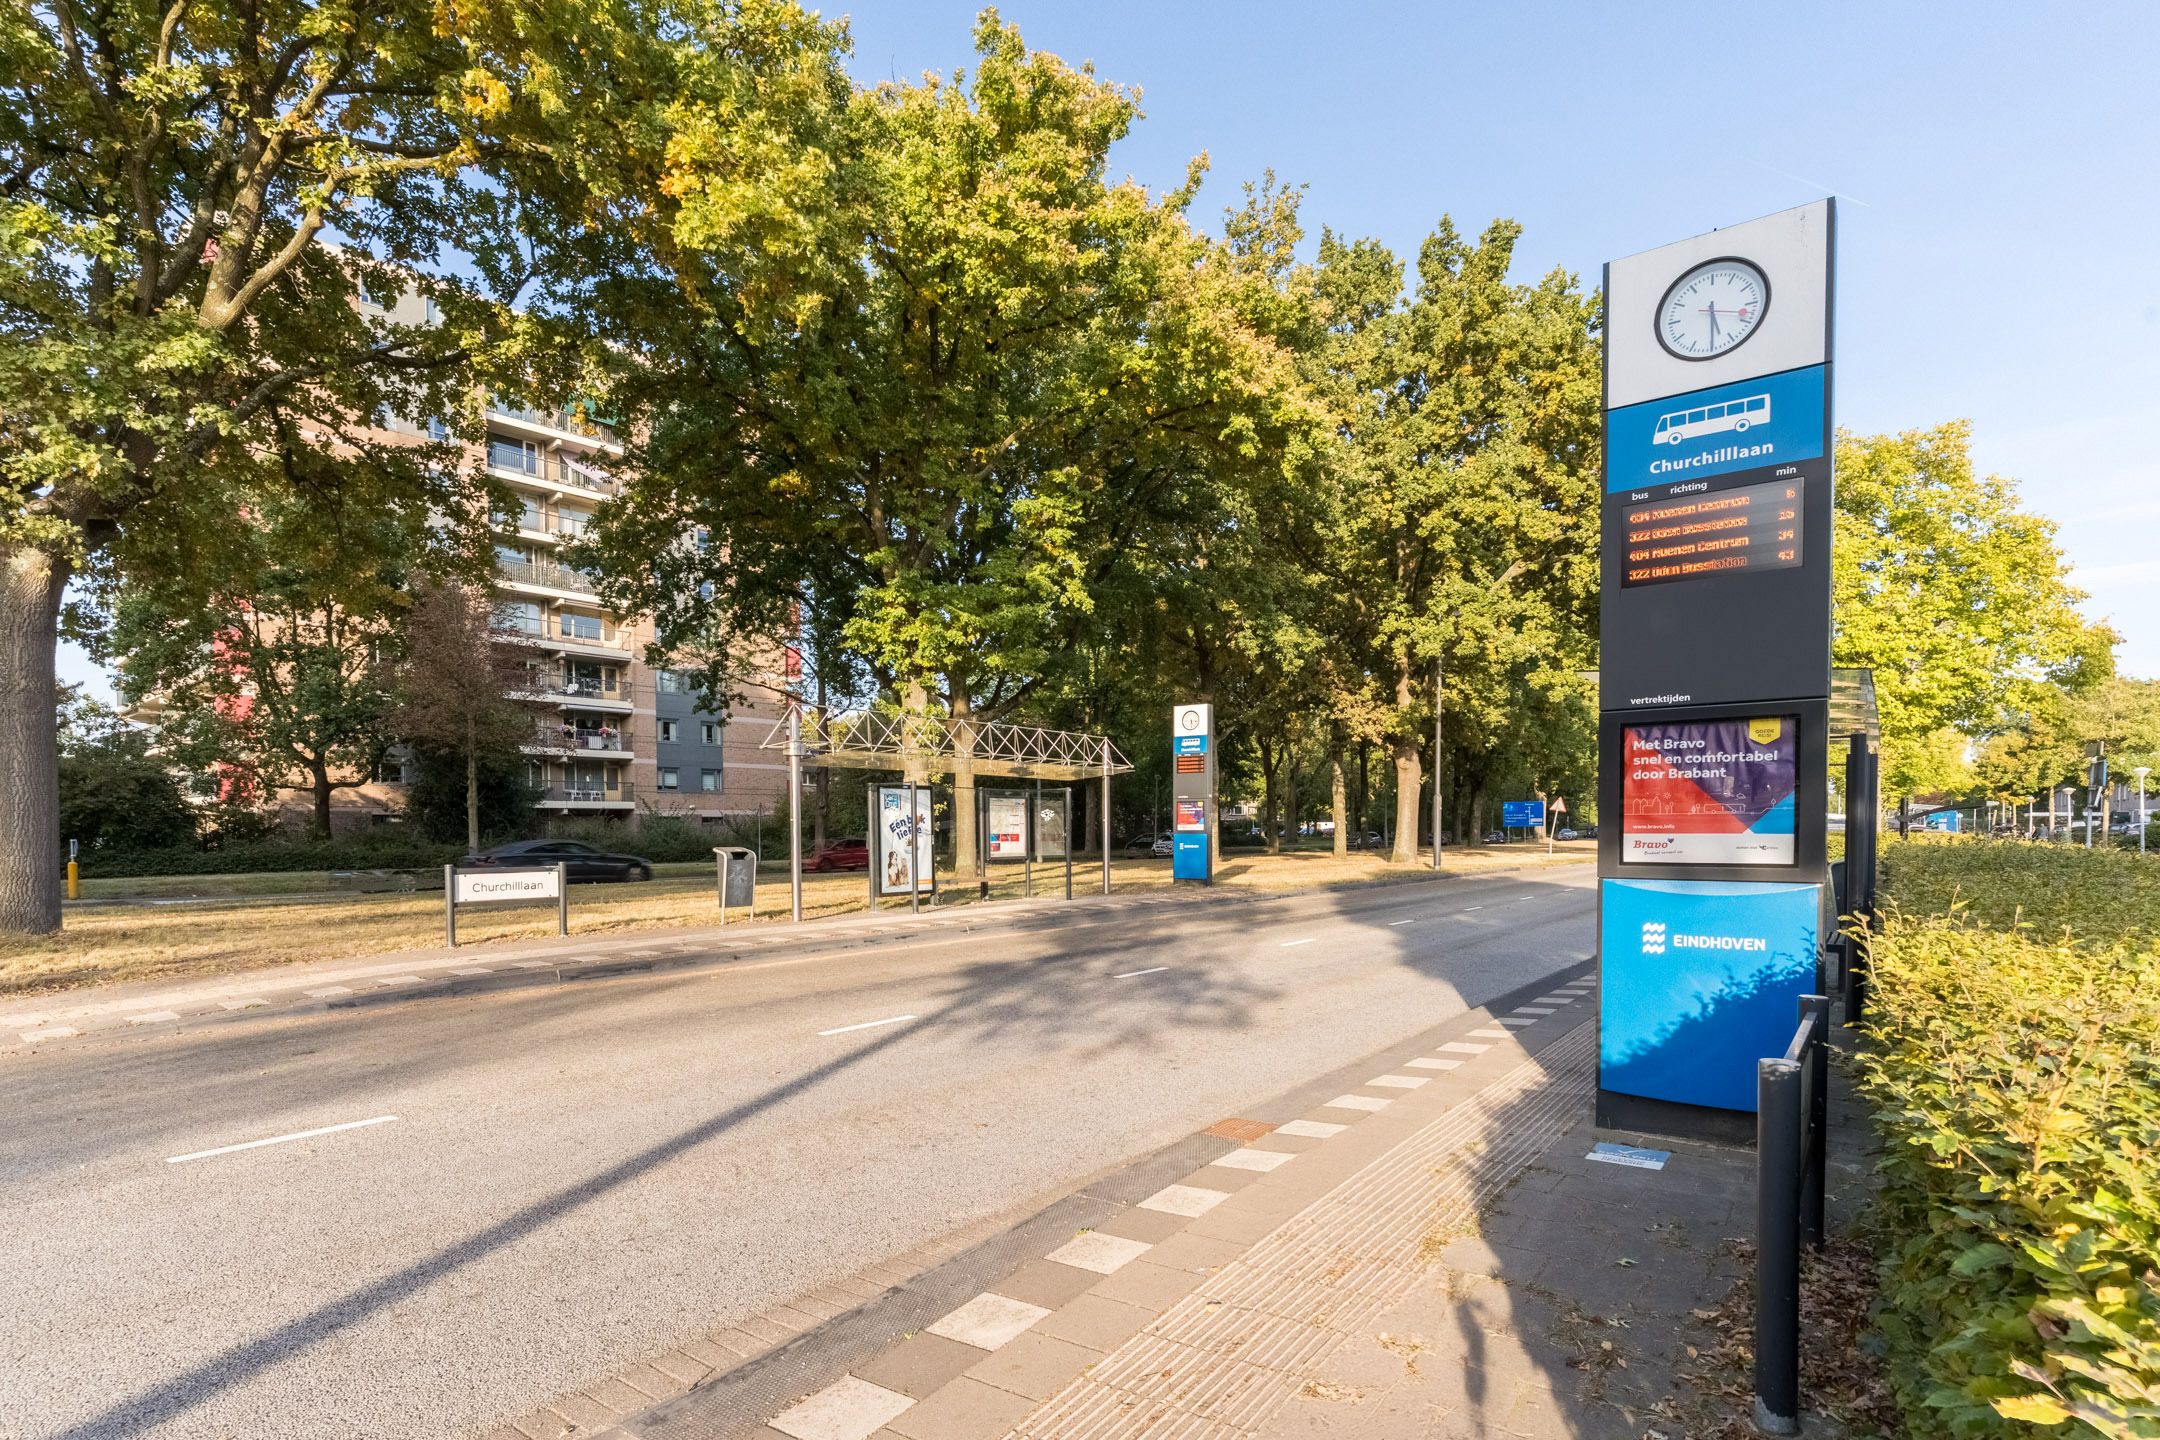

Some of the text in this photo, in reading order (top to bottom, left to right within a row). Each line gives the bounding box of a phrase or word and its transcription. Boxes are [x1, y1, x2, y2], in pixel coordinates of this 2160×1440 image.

[1650, 443, 1774, 474] Churchilllaan
[1632, 465, 1797, 501] bus richting min
[1652, 544, 1696, 558] Nuenen
[1698, 537, 1749, 552] Centrum
[1629, 569, 1650, 580] 322
[1652, 566, 1680, 577] Uden
[1682, 557, 1747, 574] Busstation
[1630, 694, 1691, 705] vertrektijden
[1633, 739, 1705, 750] Met Bravo
[1633, 750, 1778, 765] snel en comfortabel
[1633, 768, 1727, 780] door Brabant
[1633, 840, 1668, 849] Bravo
[472, 881, 544, 893] Churchilllaan
[1673, 934, 1766, 951] EINDHOVEN
